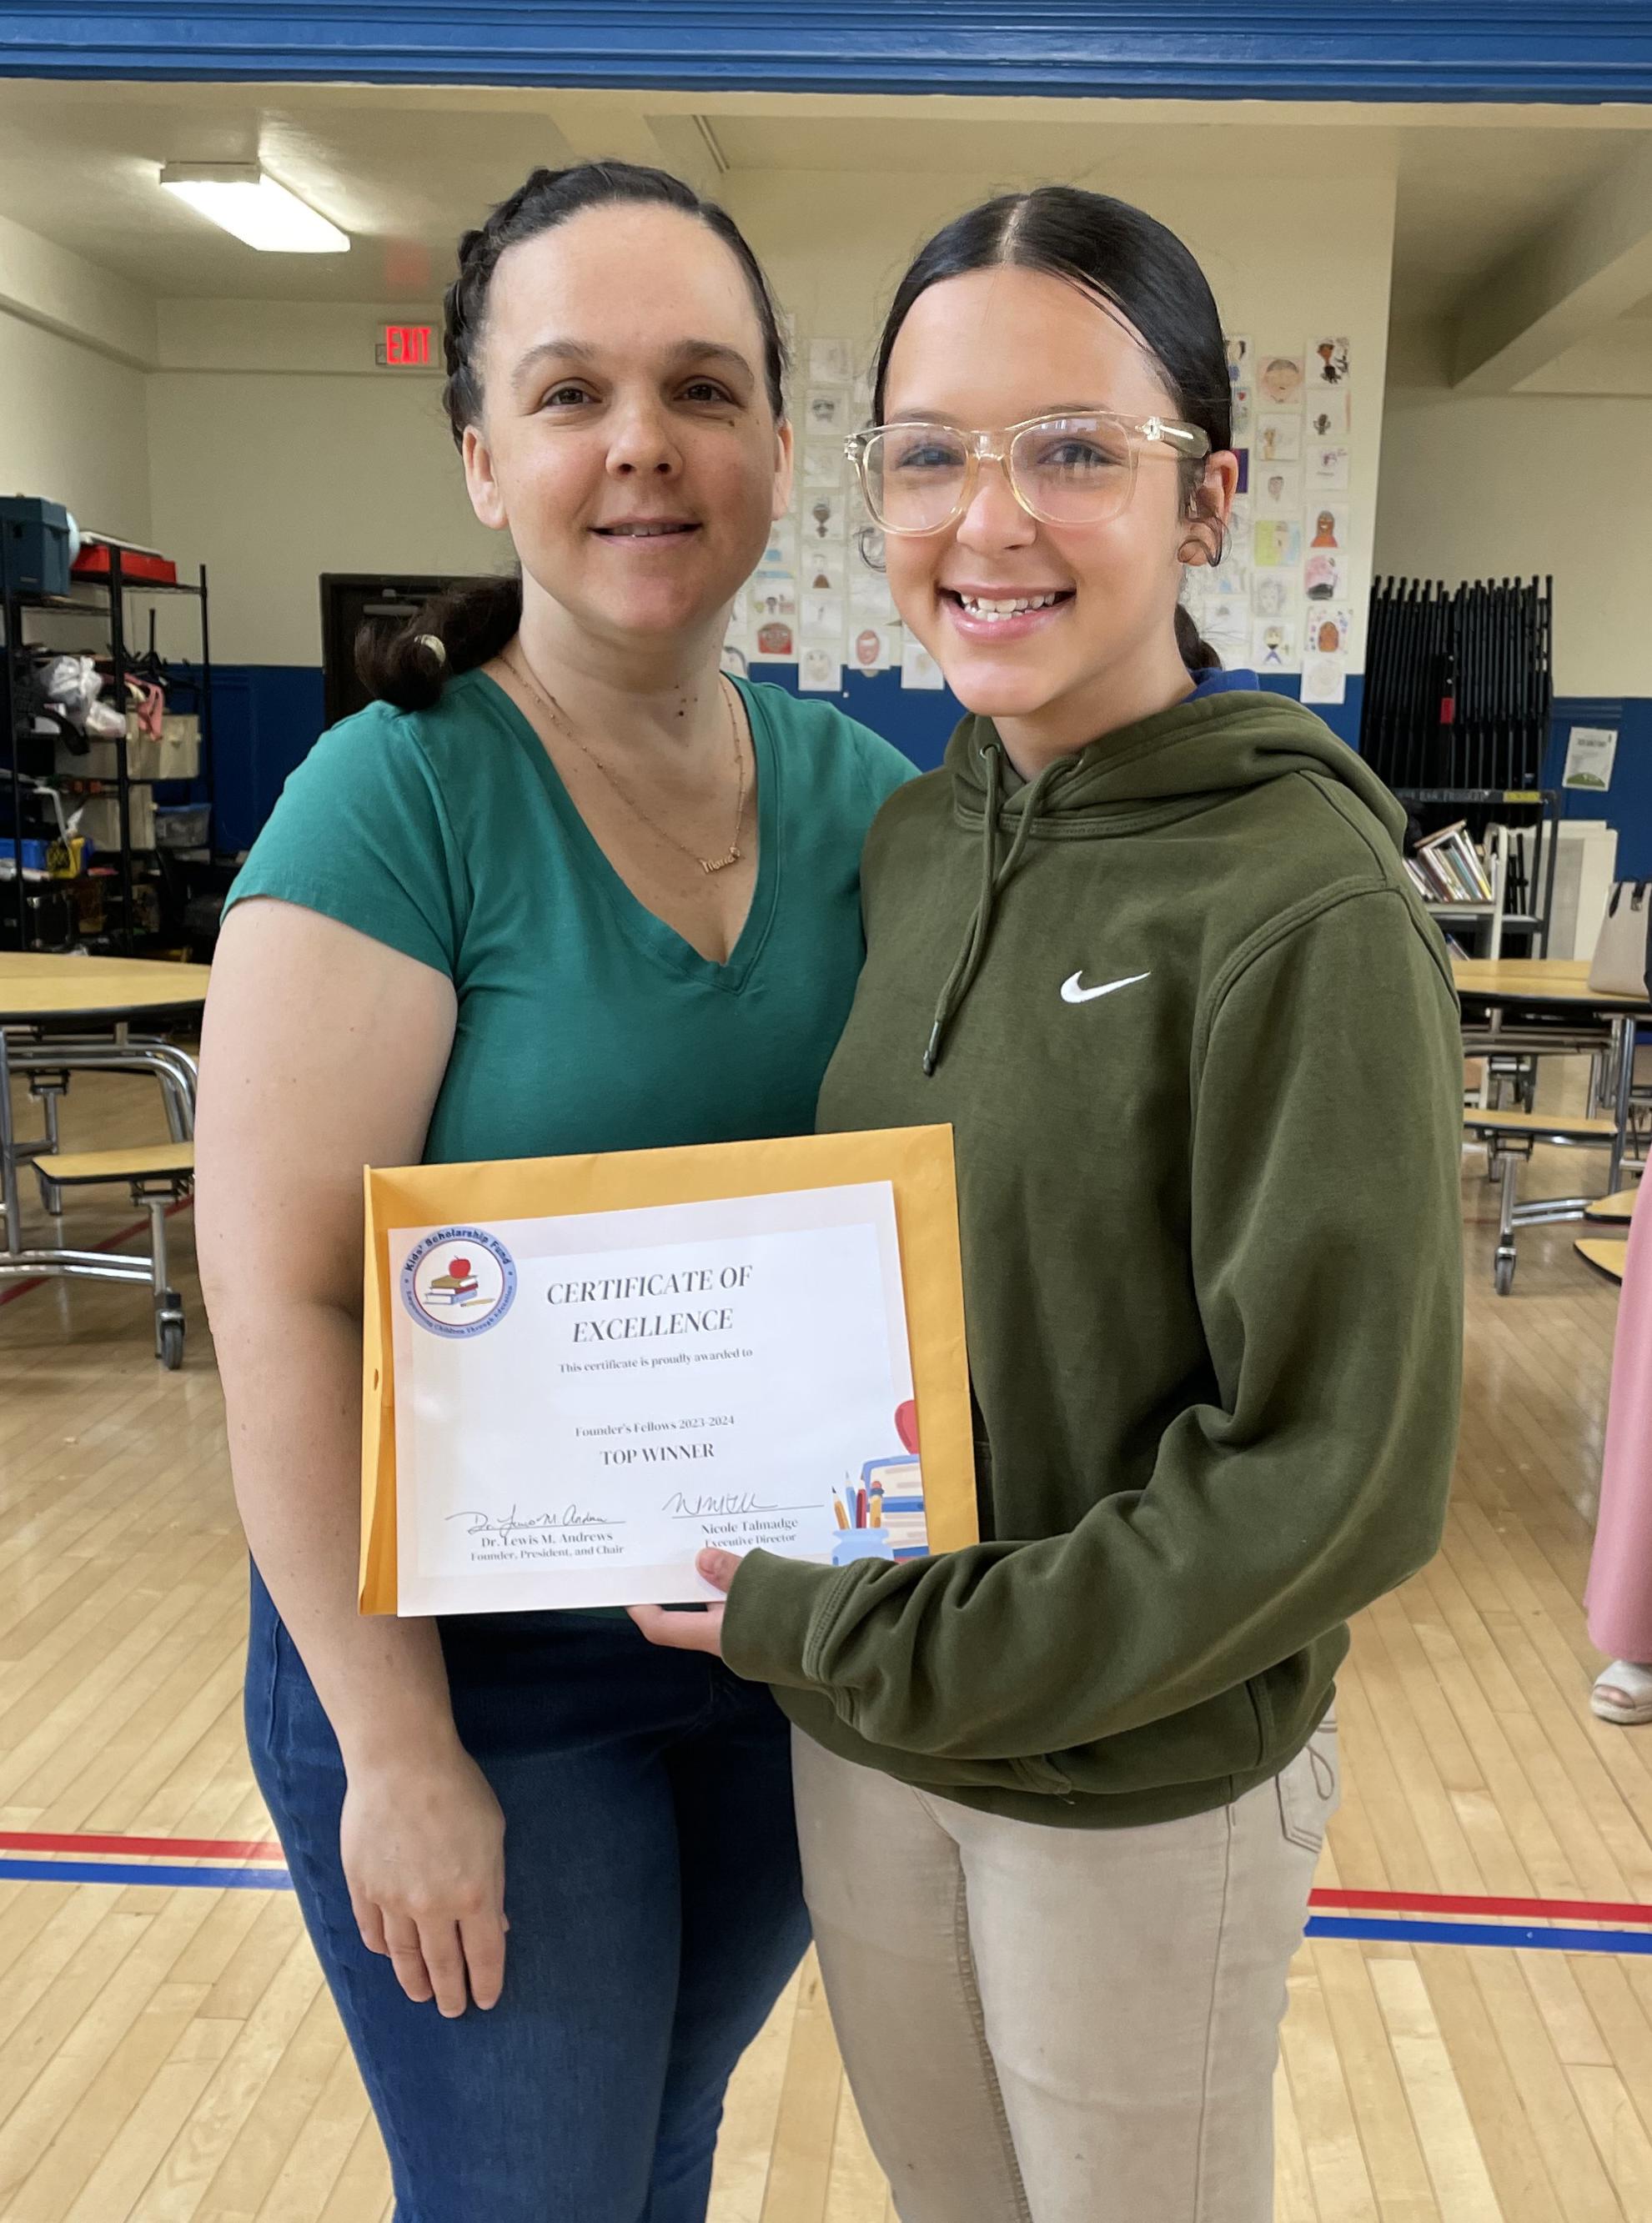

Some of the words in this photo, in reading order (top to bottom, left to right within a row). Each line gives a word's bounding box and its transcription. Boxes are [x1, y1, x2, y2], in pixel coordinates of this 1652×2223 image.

[386, 325, 431, 365] EXIT
[405, 1245, 423, 1272] Kids'
[424, 1228, 490, 1247] Scholarship
[490, 1240, 512, 1265] Fund
[547, 1269, 714, 1305] CERTIFICATE
[720, 1265, 753, 1289] OF
[573, 1307, 734, 1342] EXCELLENCE
[559, 1362, 582, 1373] This
[584, 1358, 638, 1372] certificate
[640, 1356, 650, 1367] is
[651, 1352, 691, 1368] proudly
[695, 1347, 740, 1362] awarded
[742, 1347, 753, 1357] to
[575, 1423, 632, 1438] Founder's
[634, 1421, 677, 1433] Fellows
[679, 1415, 735, 1430] 2023-2024
[600, 1449, 637, 1466] TOP
[641, 1443, 715, 1463] WINNER
[701, 1522, 738, 1534] Nicole
[741, 1518, 798, 1532] Talmadge
[481, 1537, 500, 1548] Dr.
[502, 1533, 539, 1547] Lewis
[542, 1534, 555, 1544] M.
[560, 1532, 613, 1543] Andrews
[705, 1536, 754, 1548] Executive
[756, 1533, 796, 1544] Director
[471, 1550, 518, 1561] Founder,
[520, 1548, 572, 1558] President,
[575, 1546, 594, 1556] and
[596, 1544, 625, 1555] Chair
